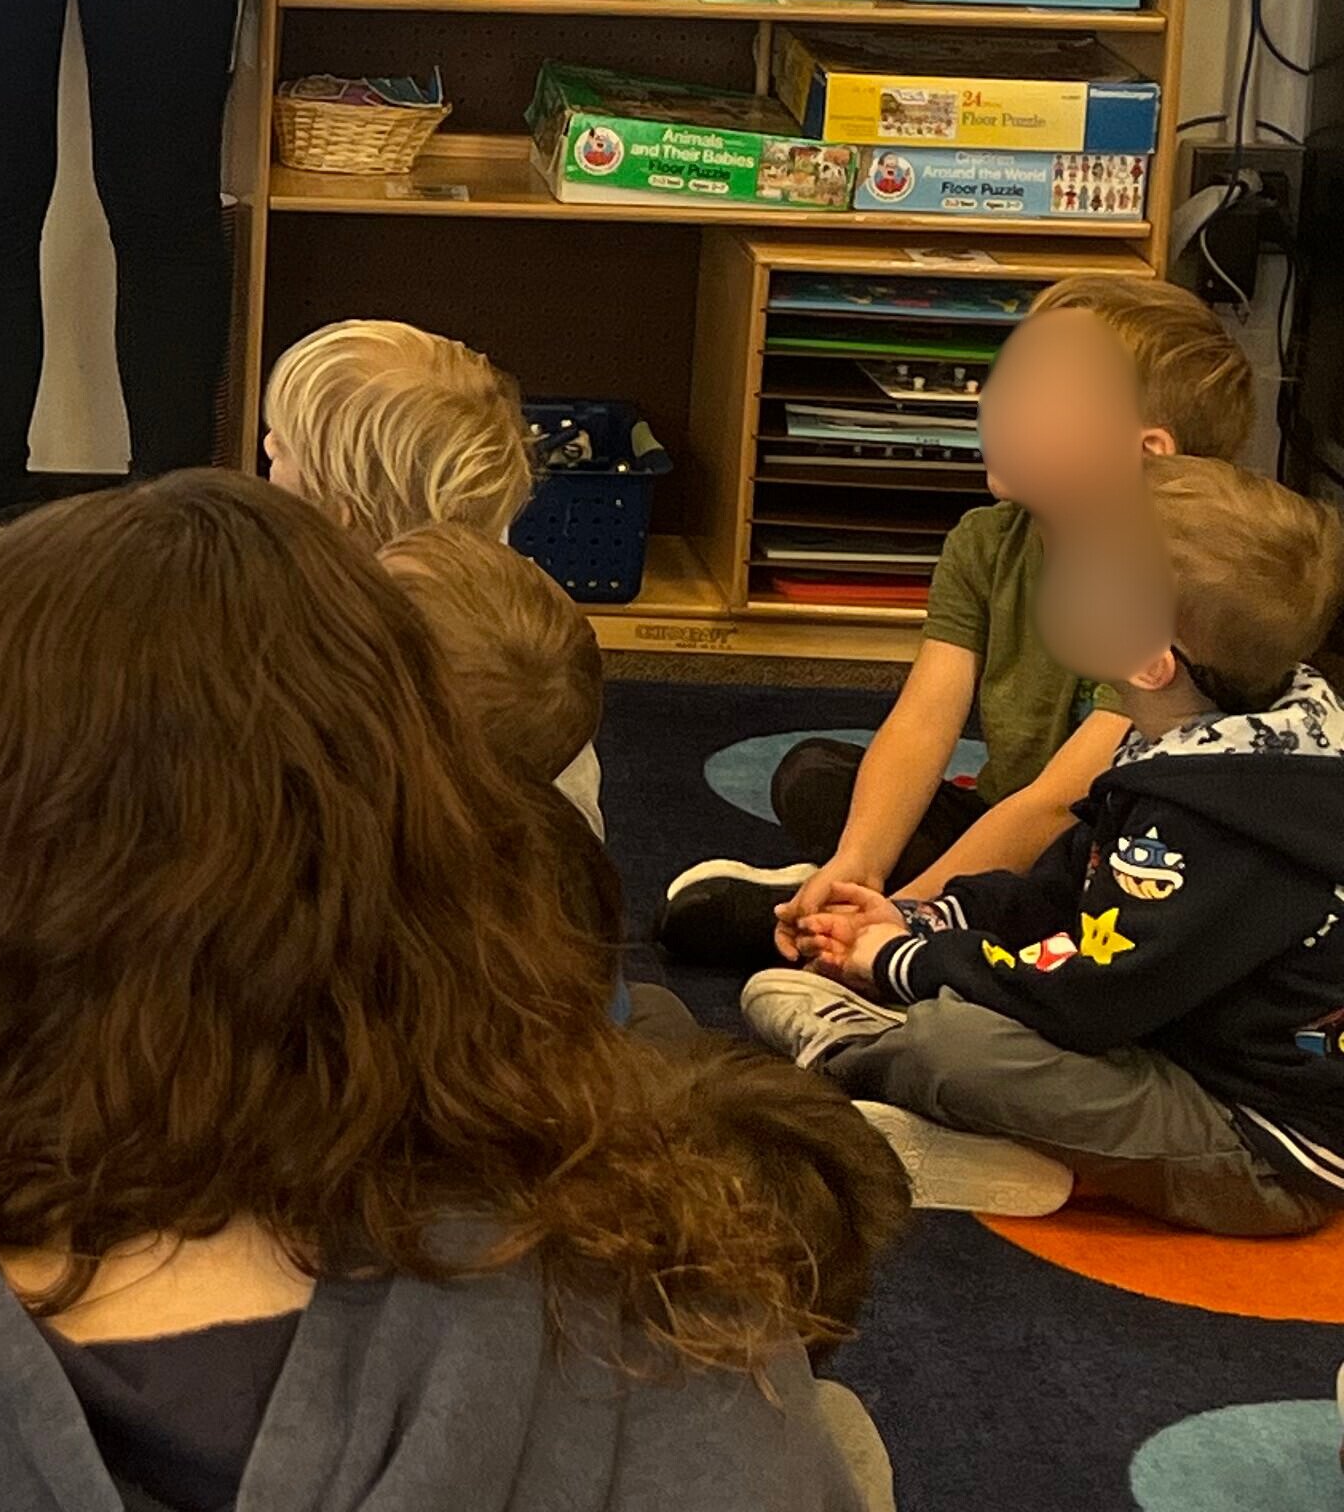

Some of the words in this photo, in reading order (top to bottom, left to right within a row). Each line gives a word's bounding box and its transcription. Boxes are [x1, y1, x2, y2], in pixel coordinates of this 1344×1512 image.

[963, 90, 983, 106] 24
[963, 111, 998, 126] Floor
[1001, 112, 1047, 128] Puzzle
[662, 128, 723, 148] Animals
[631, 143, 660, 157] and
[661, 146, 701, 162] Their
[702, 149, 755, 168] Babies
[648, 160, 686, 175] Floor
[688, 163, 732, 180] Puzzle
[922, 165, 976, 180] Around
[978, 167, 1002, 180] the
[1005, 168, 1047, 183] World
[940, 181, 978, 195] Floor
[980, 183, 1025, 198] Puzzle
